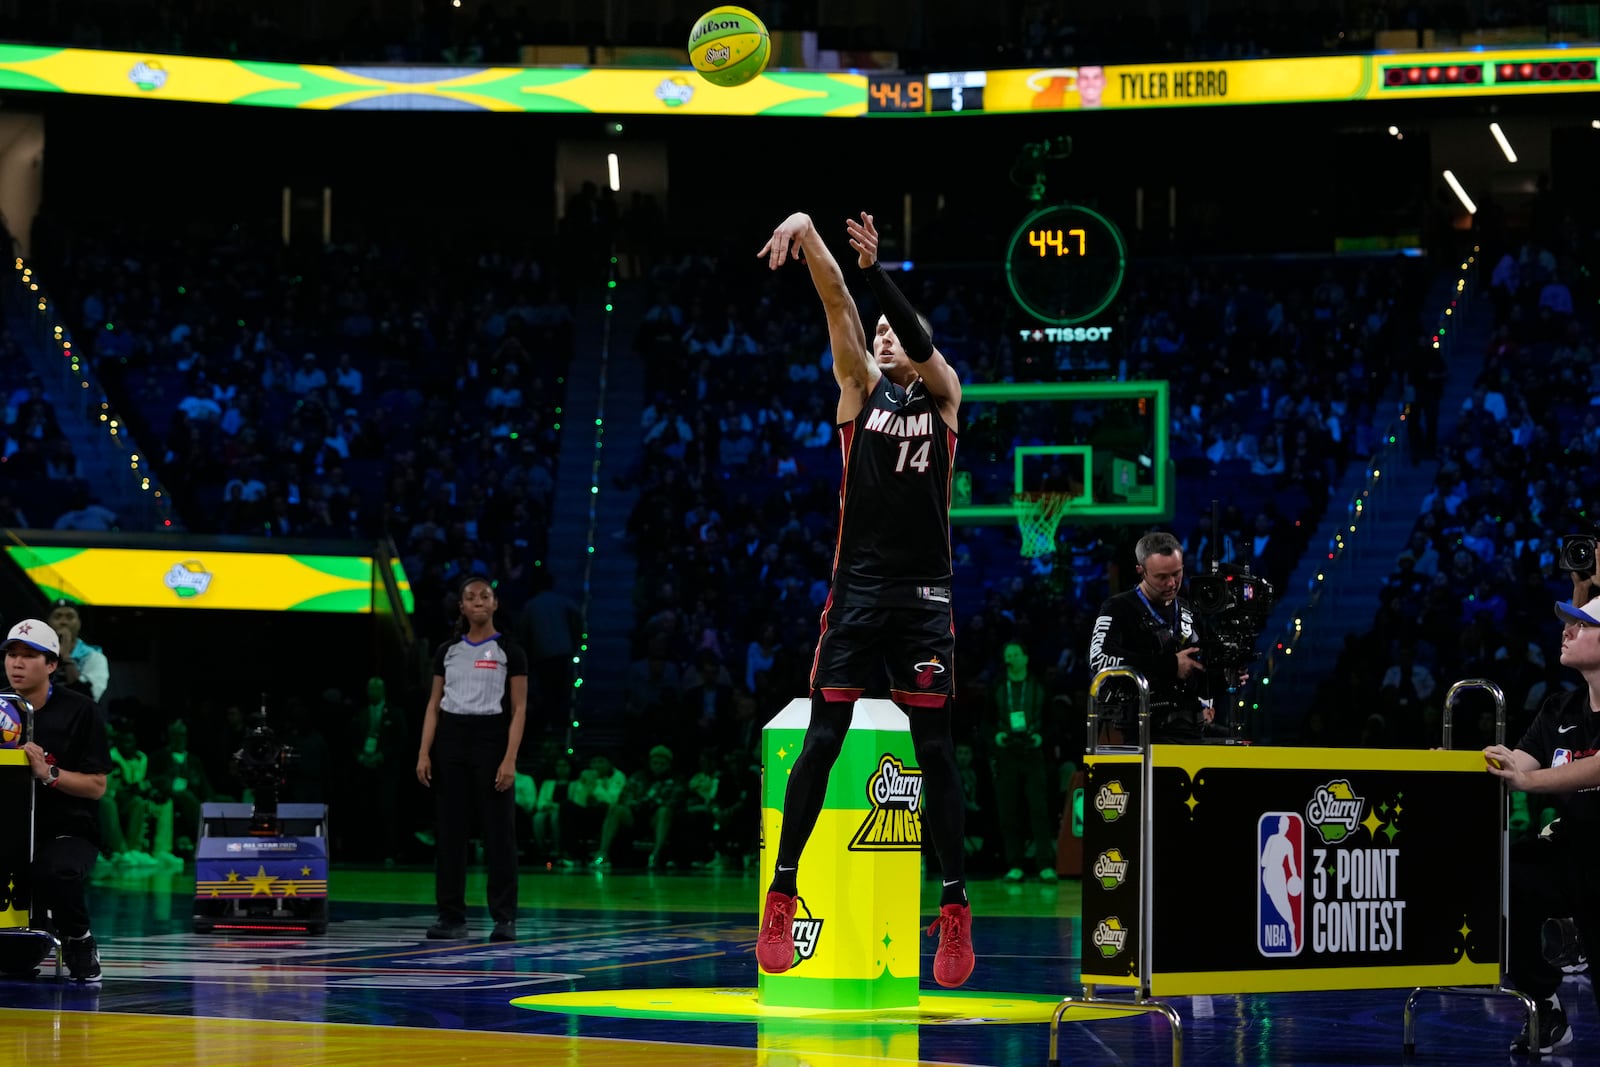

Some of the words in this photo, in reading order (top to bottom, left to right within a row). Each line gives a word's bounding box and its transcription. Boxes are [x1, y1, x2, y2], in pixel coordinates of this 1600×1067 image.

[692, 20, 740, 42] Wilson
[706, 46, 730, 64] Starry
[870, 82, 923, 108] 44.9
[1119, 72, 1168, 100] TYLER
[1174, 70, 1227, 98] HERRO
[951, 87, 963, 111] 5
[1029, 229, 1086, 257] 44.7
[1044, 326, 1113, 343] TISSOT
[864, 408, 933, 438] MIAMI
[895, 440, 931, 473] 14
[875, 762, 922, 811] Starry
[1096, 787, 1127, 813] Starry
[1308, 789, 1361, 831] Starry
[1095, 854, 1126, 881] Starry
[1336, 848, 1400, 900] POINT
[1094, 923, 1125, 950] Starry
[1265, 924, 1287, 947] NBA
[1312, 901, 1406, 953] CONTEST
